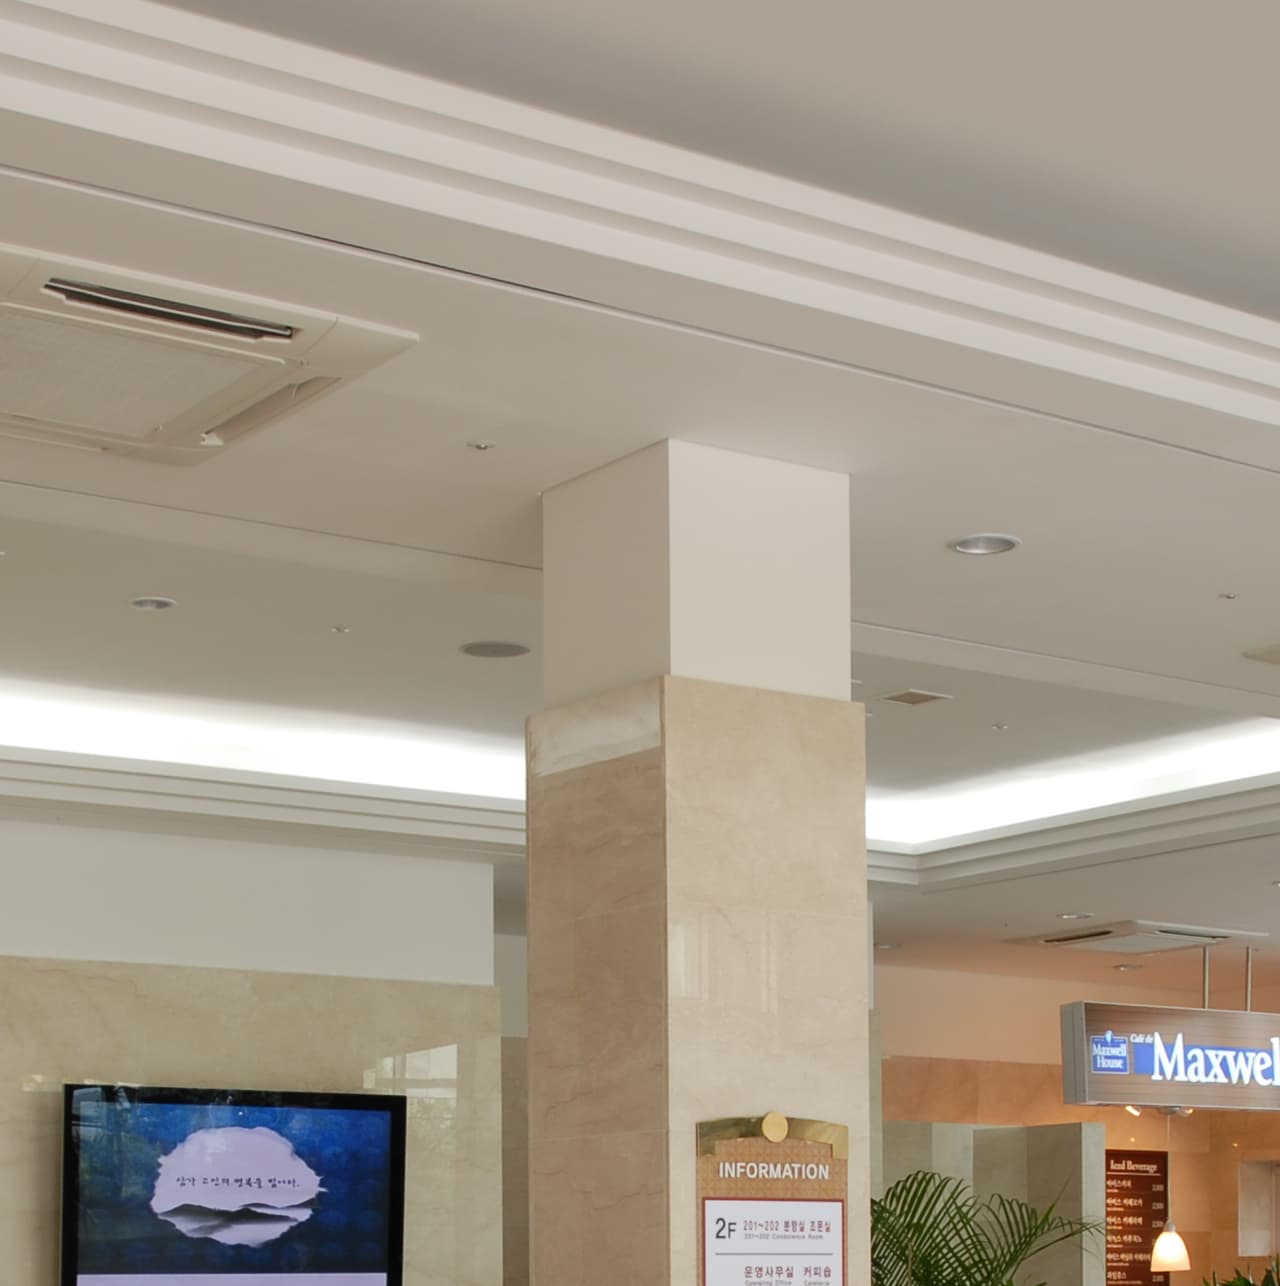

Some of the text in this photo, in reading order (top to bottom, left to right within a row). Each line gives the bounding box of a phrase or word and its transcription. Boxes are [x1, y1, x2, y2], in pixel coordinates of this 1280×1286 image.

[1092, 1043, 1127, 1056] Maxwell
[1097, 1056, 1124, 1069] House
[719, 1162, 830, 1180] INFORMATION
[1127, 1160, 1158, 1174] Beverage
[715, 1217, 737, 1239] 2F
[744, 1265, 832, 1279] 운영사무실 커피숍
